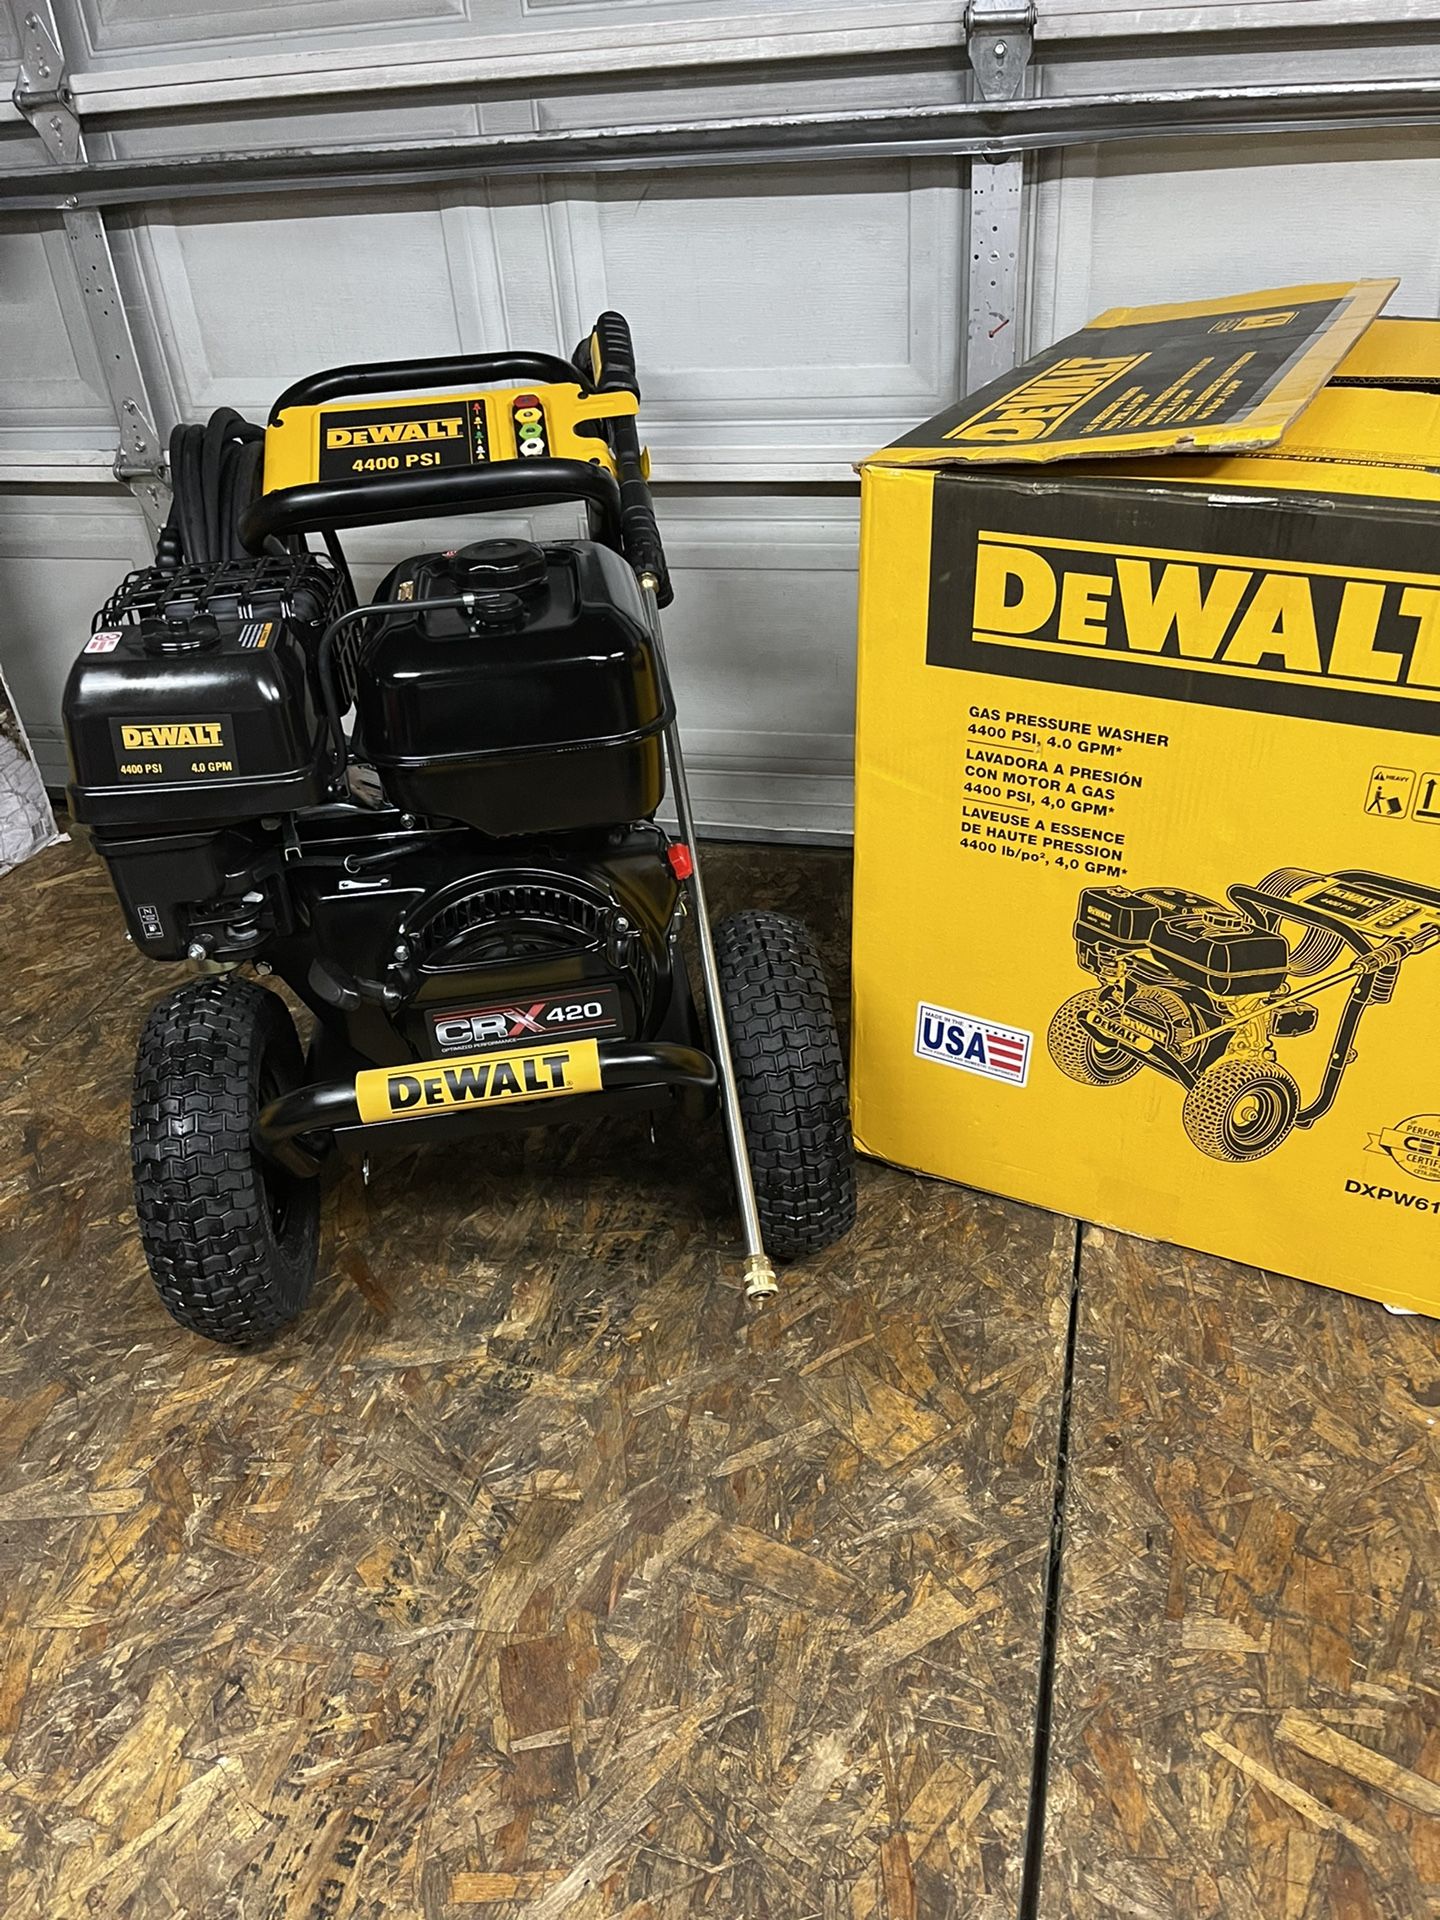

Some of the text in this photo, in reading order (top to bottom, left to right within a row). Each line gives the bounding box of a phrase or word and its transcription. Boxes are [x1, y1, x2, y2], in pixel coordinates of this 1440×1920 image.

[956, 356, 1125, 441] DEWALT
[327, 417, 462, 447] DEWALT
[352, 451, 441, 472] 4400 PSI
[122, 726, 222, 747] DEWALT
[968, 723, 1006, 739] 4400
[1011, 730, 1041, 747] PSI,
[1047, 736, 1072, 750] 4.0
[969, 706, 1170, 747] GAS PRESSURE WASHER
[120, 761, 233, 774] 4400 PSI 4.0 GPM
[965, 765, 1116, 800] CON MOTOR A GAS
[966, 748, 1143, 788] LAVADORA A PRESIÓN
[963, 782, 1001, 798] 4400
[1007, 790, 1035, 806] PSI,
[1041, 796, 1065, 810] 4,0
[961, 822, 1123, 862] DE HAUTE PRESSION
[962, 806, 1125, 845] LAVEUSE A ESSENCE
[960, 838, 997, 854] 4400
[1055, 856, 1079, 871] 4,0
[435, 1002, 602, 1046] CRX 420
[924, 1017, 986, 1064] USA
[1093, 1015, 1141, 1043] DEWALT
[388, 1055, 571, 1110] DEWALT
[1345, 1180, 1440, 1214] DXPW61
